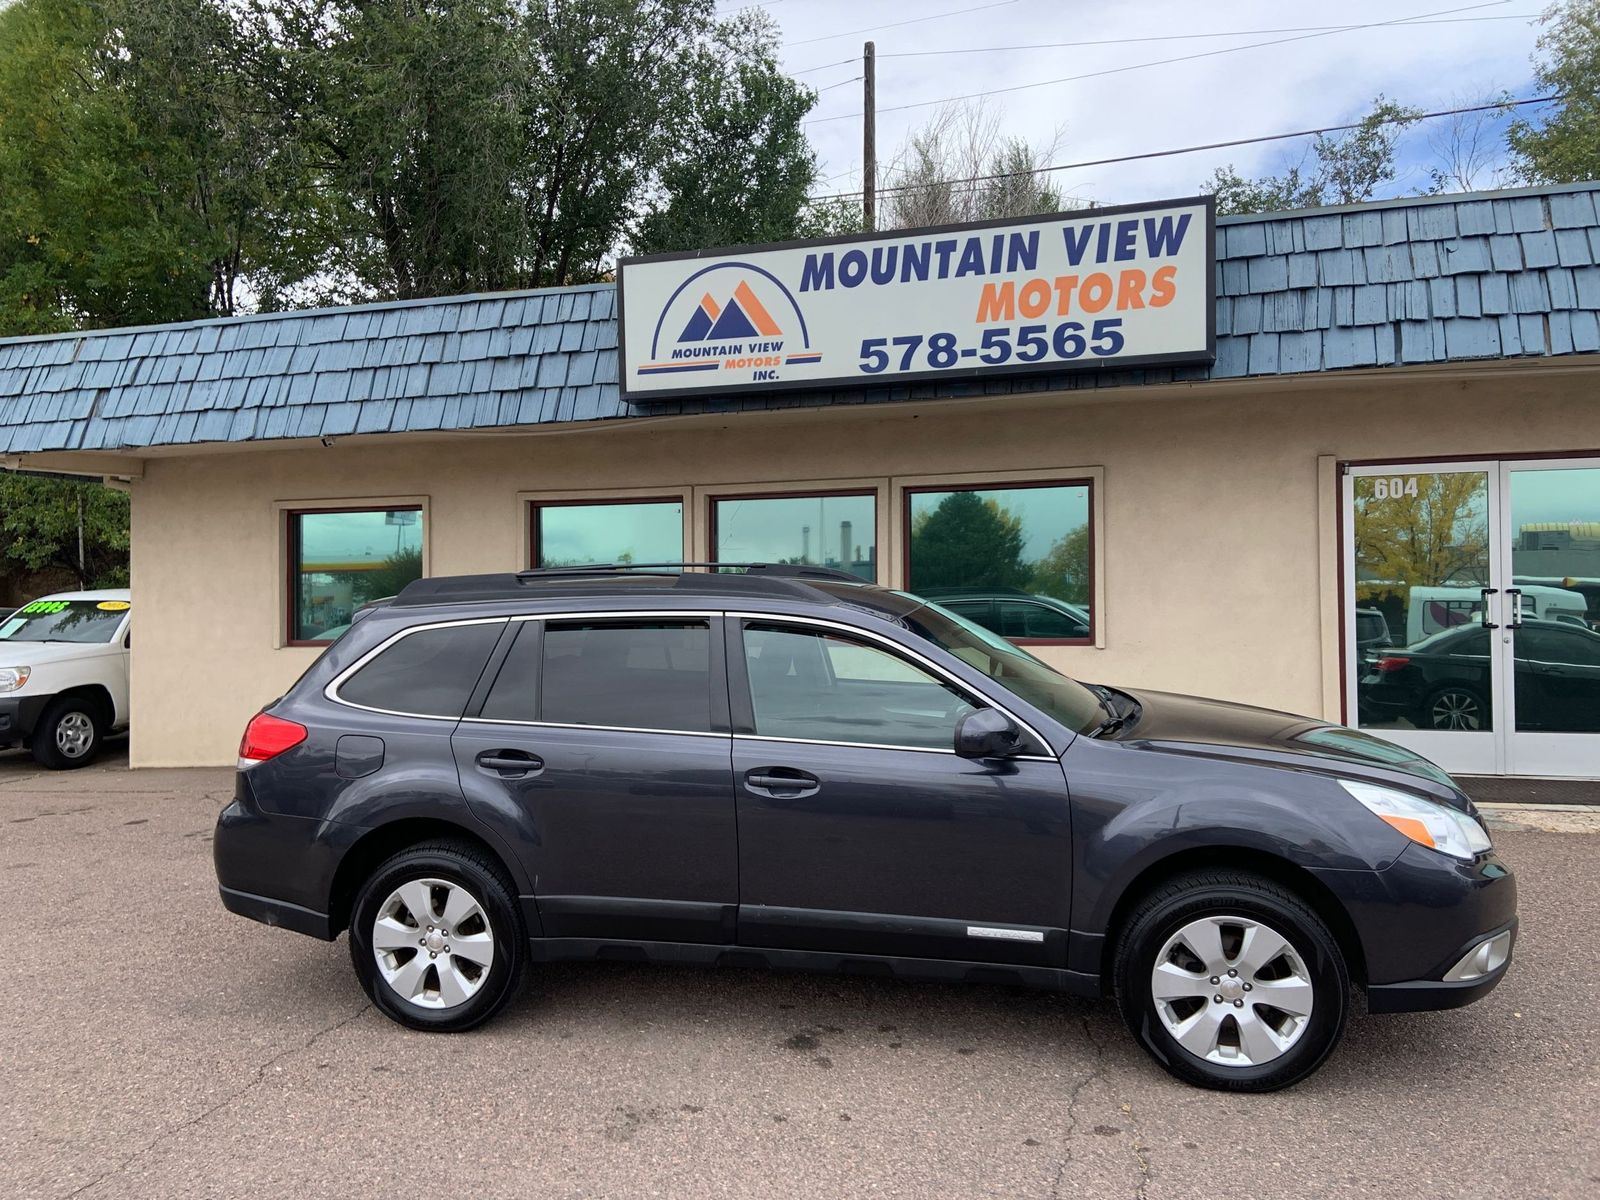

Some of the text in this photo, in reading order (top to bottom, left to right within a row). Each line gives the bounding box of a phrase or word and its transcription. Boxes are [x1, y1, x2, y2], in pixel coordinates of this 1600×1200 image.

[799, 214, 1192, 292] MOUNTAIN VIEW
[975, 265, 1178, 324] MOTORS
[671, 341, 784, 359] MOUNTAIN VIEW
[859, 318, 1125, 373] 578-5565
[724, 356, 782, 369] MOTORS
[752, 370, 780, 381] INC.
[1374, 477, 1418, 500] 604
